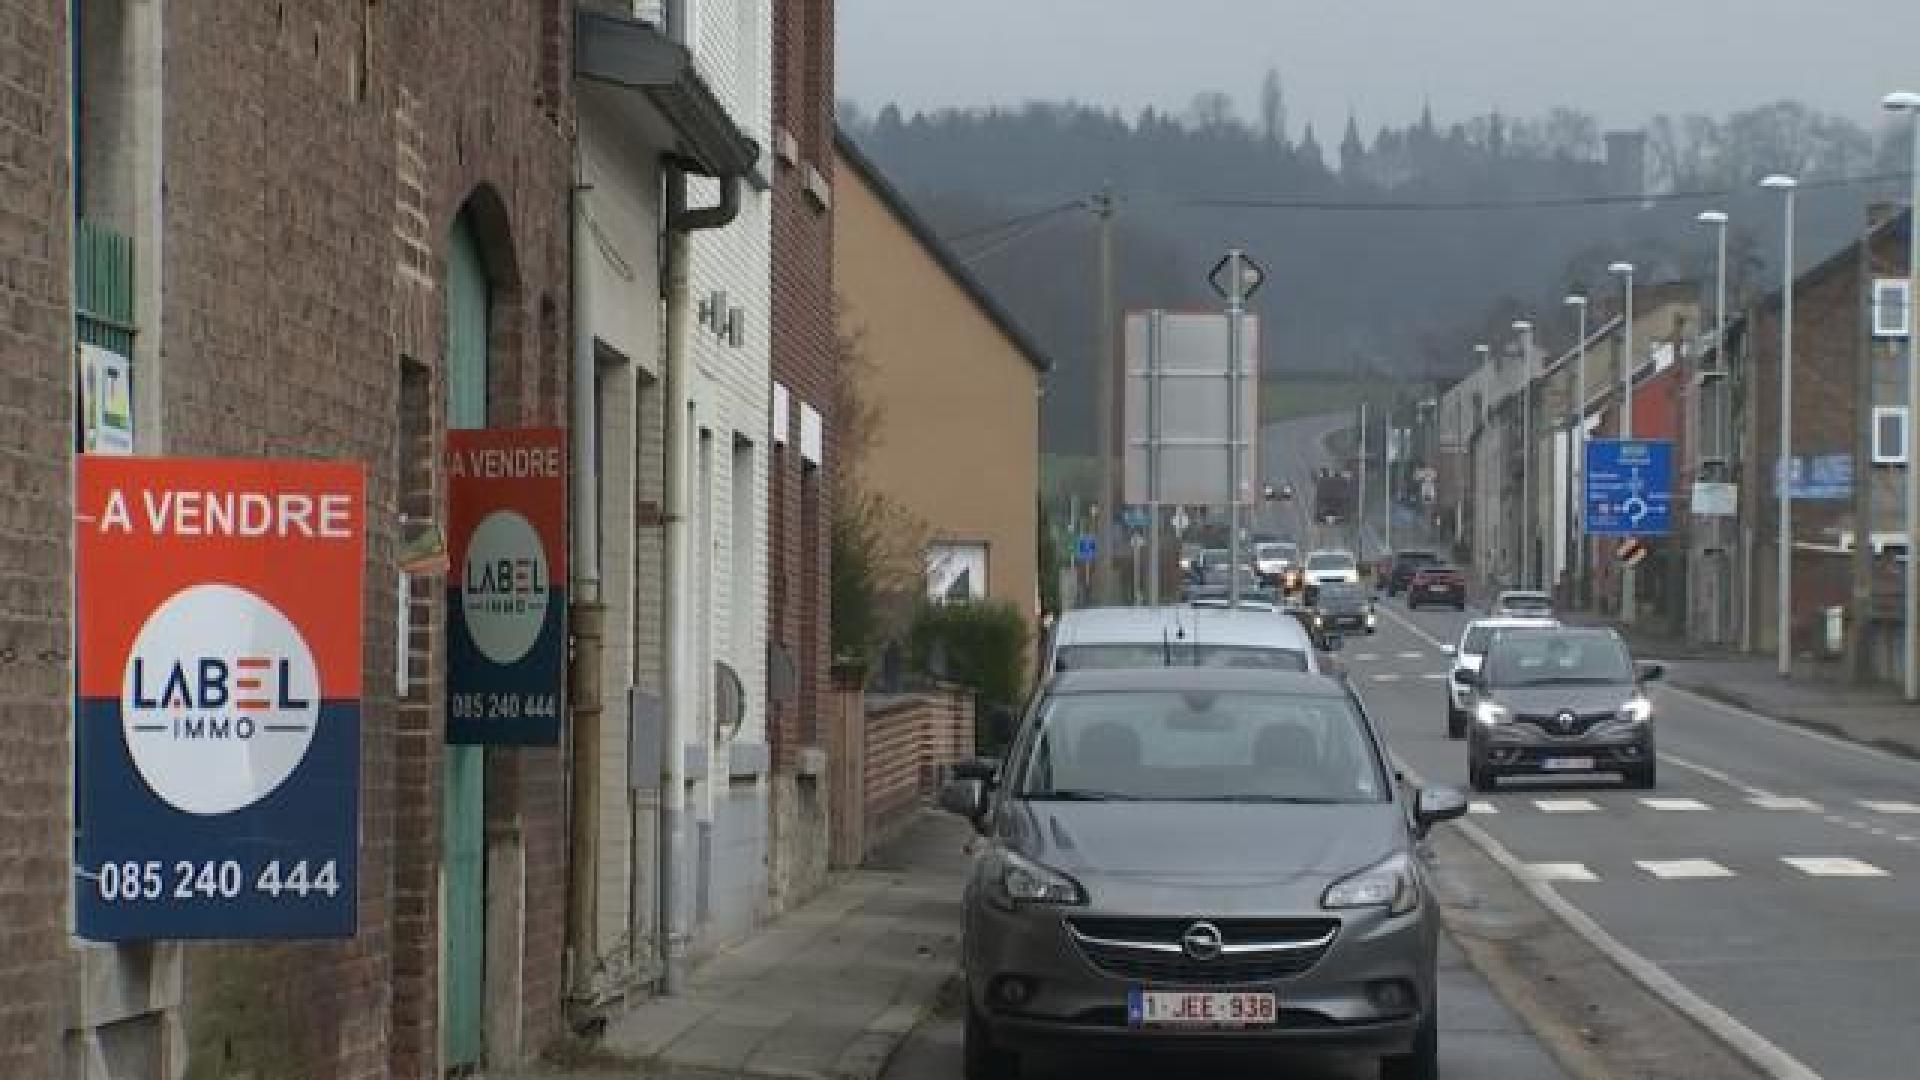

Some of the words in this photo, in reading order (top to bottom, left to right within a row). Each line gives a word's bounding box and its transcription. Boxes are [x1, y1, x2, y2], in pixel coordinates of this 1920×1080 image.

[450, 449, 466, 478] A
[470, 447, 559, 478] VENDRE
[100, 488, 133, 535] A
[143, 488, 352, 537] VENDRE
[467, 558, 544, 595] LABEL
[485, 599, 526, 615] IMMO
[134, 656, 310, 709] LABEL
[453, 693, 483, 718] 085
[489, 693, 520, 718] 240
[525, 692, 555, 718] 444
[173, 716, 255, 740] IMMO
[100, 860, 163, 900] 085
[174, 860, 242, 899] 240
[256, 860, 340, 898] 444
